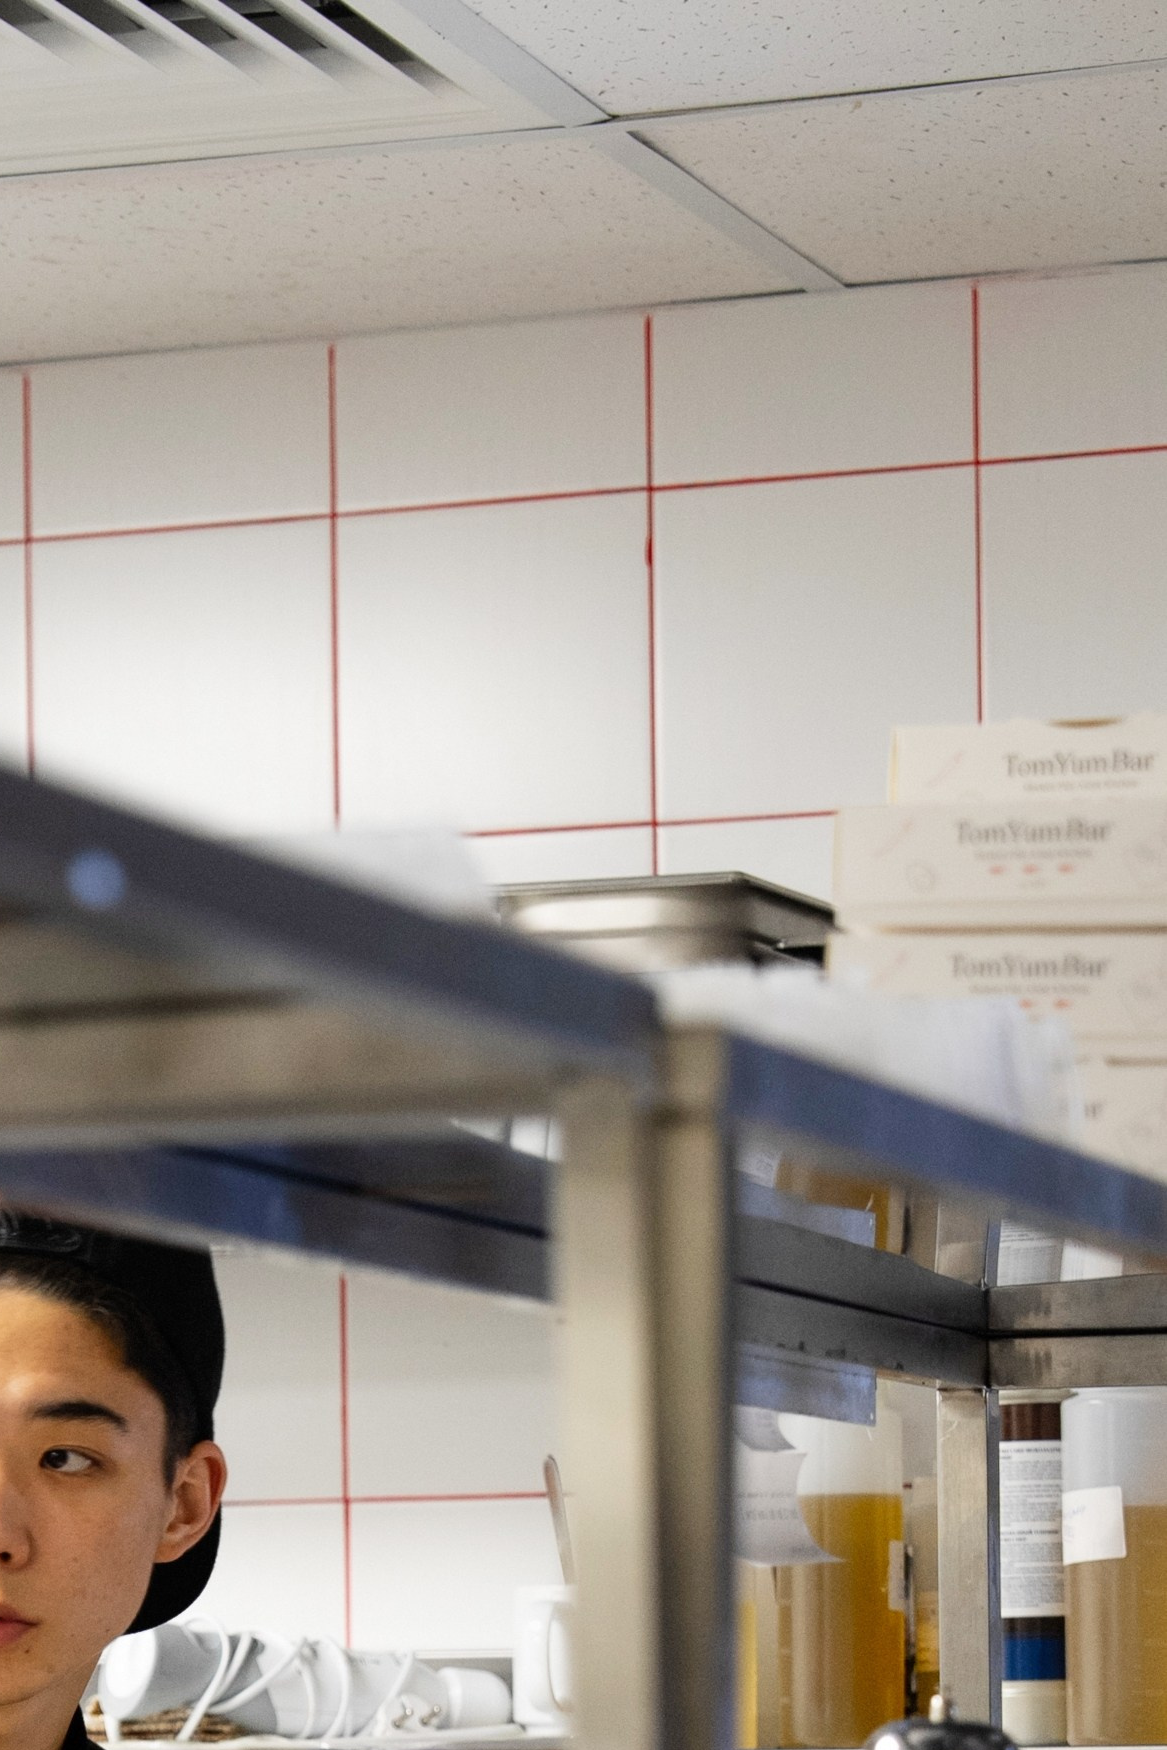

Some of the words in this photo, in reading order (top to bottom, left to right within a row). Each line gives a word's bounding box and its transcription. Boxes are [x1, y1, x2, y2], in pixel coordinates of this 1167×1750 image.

[1004, 750, 1155, 777] TomYumBar
[955, 817, 1112, 844] TomYumBar
[950, 953, 1109, 979] TomYumBar
